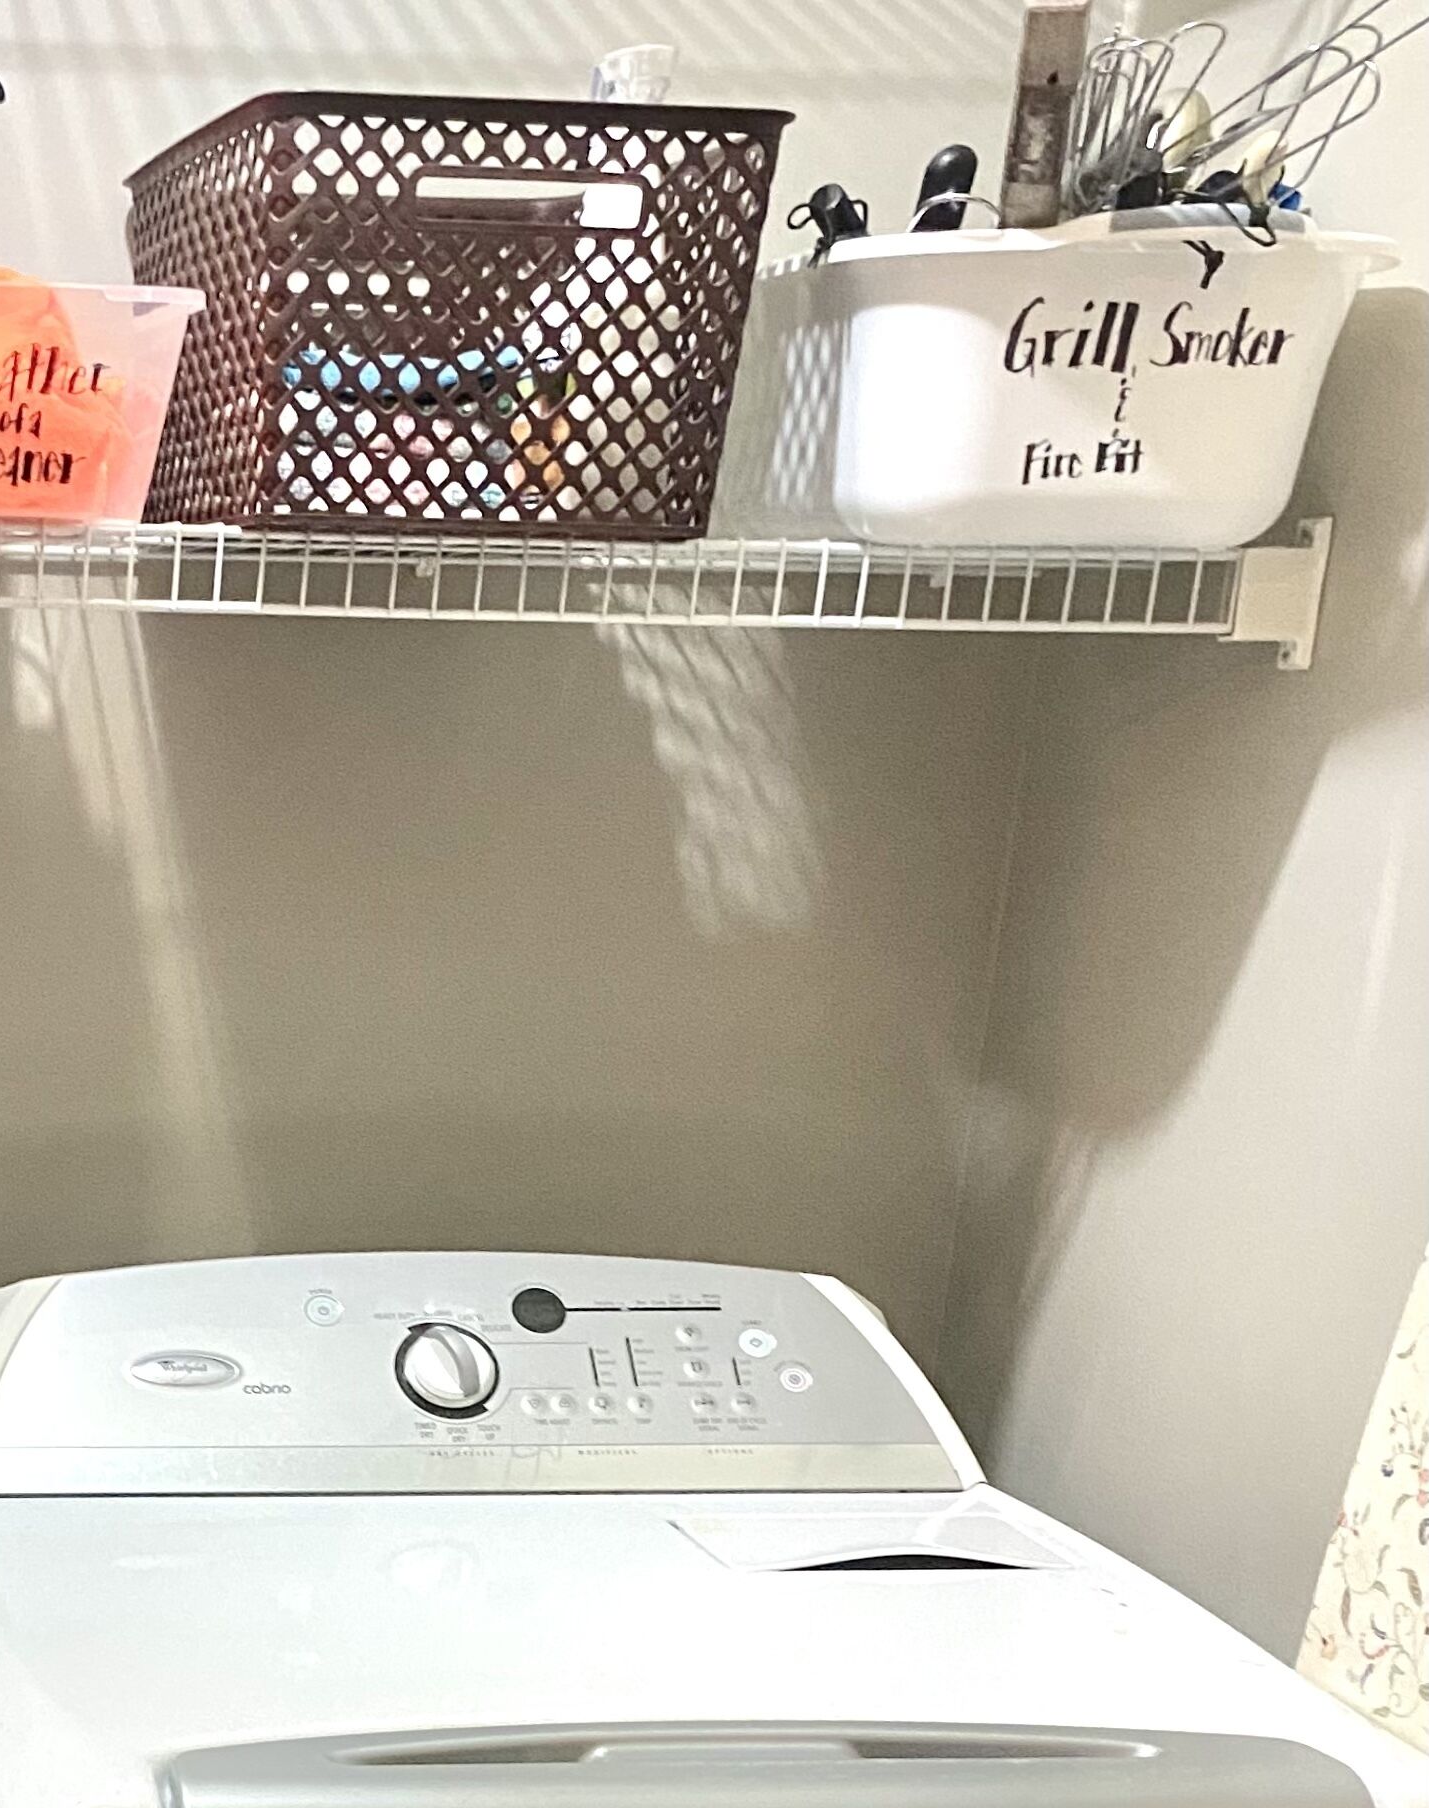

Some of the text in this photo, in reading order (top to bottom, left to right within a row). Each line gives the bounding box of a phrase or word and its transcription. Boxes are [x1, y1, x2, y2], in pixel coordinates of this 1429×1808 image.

[1149, 301, 1296, 367] Smoker
[1021, 438, 1084, 485] Fire
[242, 1382, 292, 1395] cabrio
